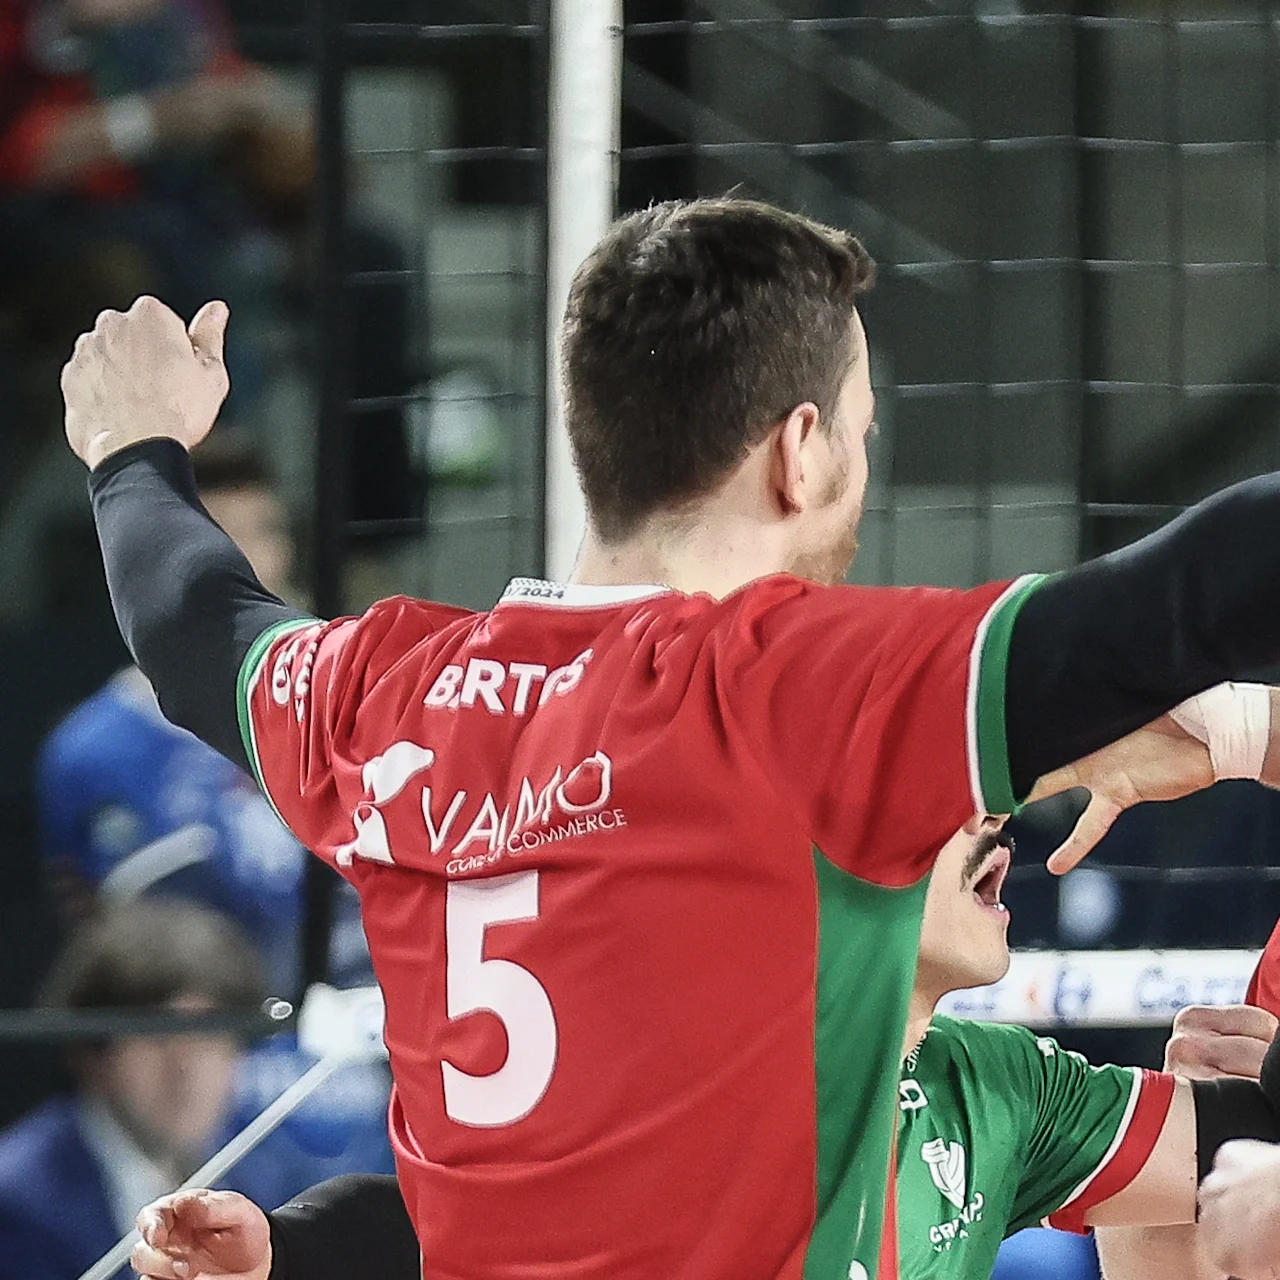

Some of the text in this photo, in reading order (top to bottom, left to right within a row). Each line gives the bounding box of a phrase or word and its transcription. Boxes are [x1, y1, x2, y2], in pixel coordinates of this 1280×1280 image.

[421, 750, 612, 854] VAIMO
[507, 808, 627, 853] COMMERCE
[441, 869, 559, 1129] 5
